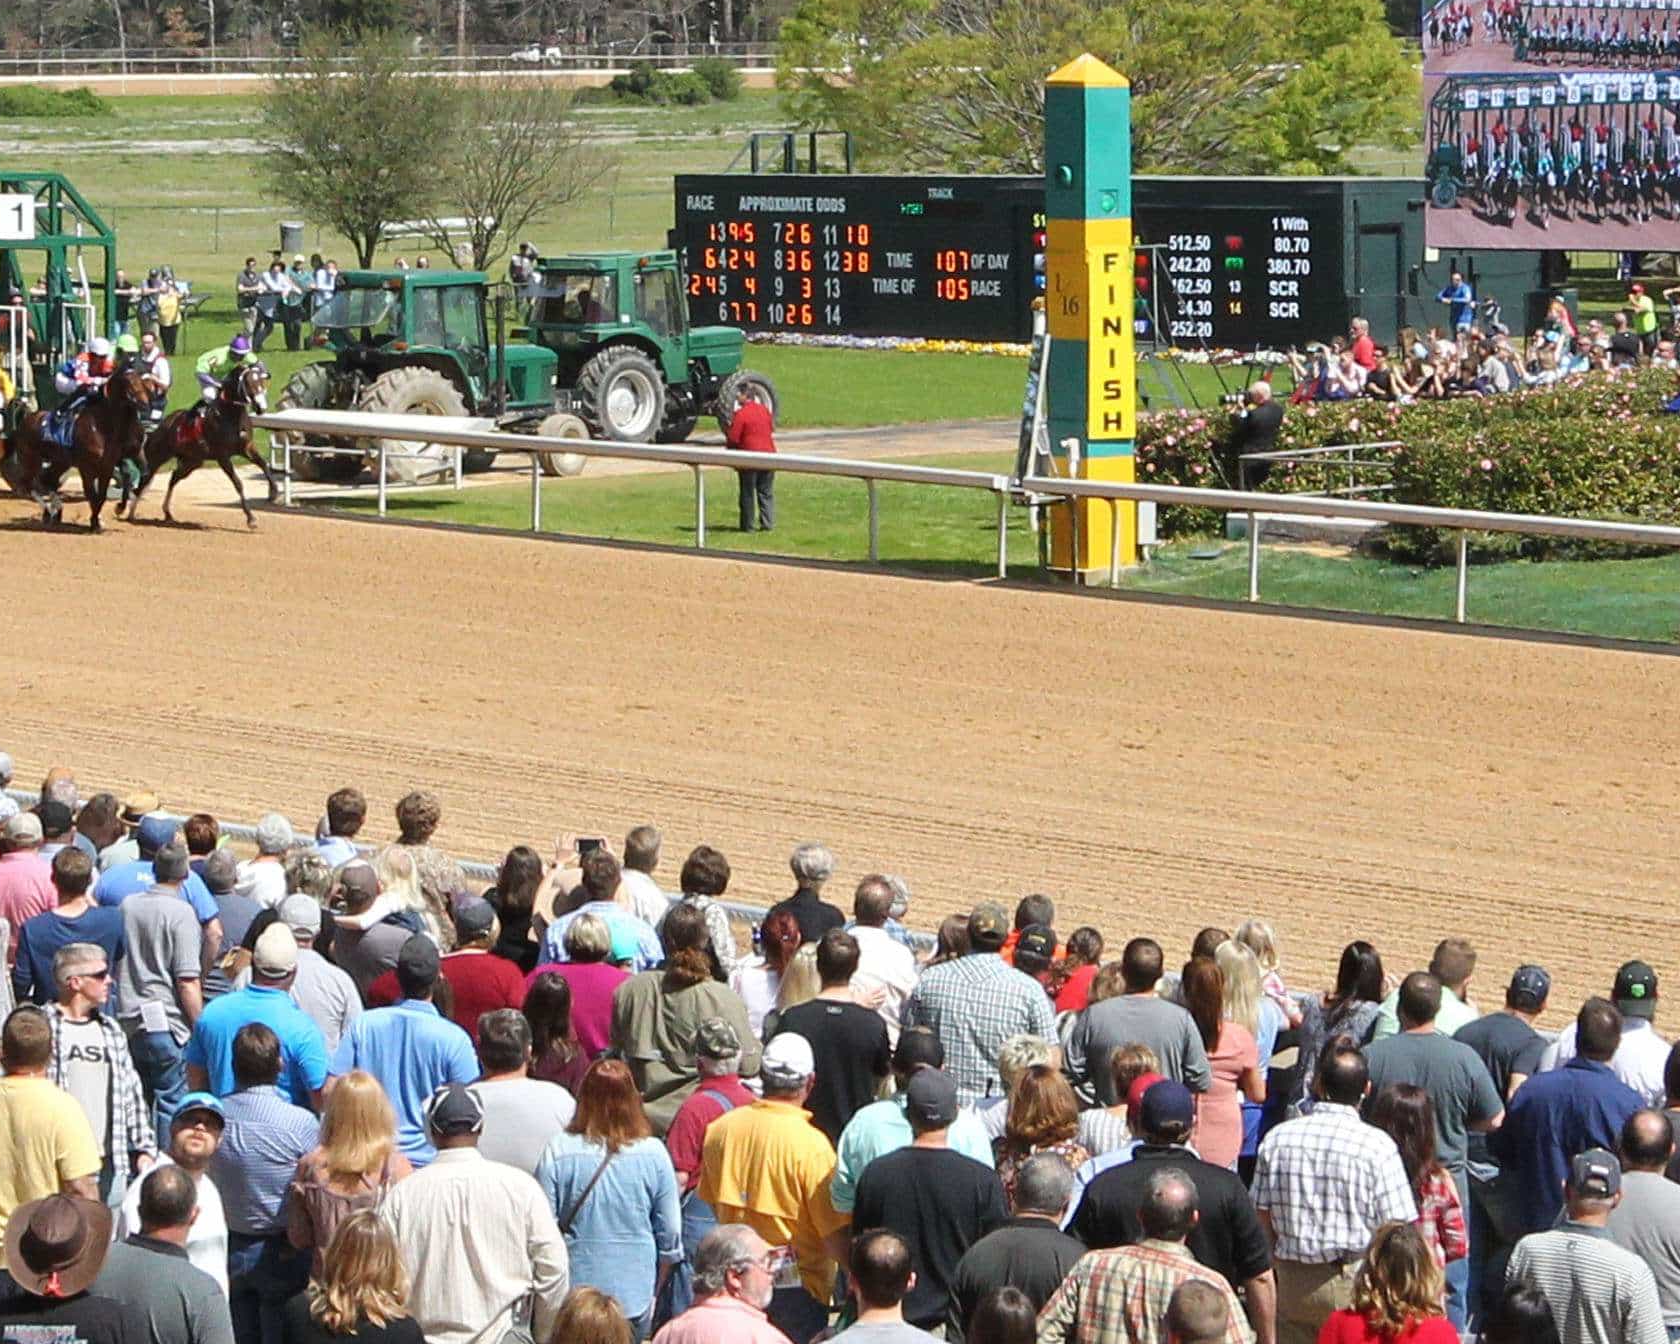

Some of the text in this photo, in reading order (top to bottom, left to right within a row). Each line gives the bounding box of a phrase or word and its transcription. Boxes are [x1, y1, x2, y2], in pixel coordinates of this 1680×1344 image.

[686, 195, 715, 211] RACE
[927, 187, 954, 200] TRACK
[739, 196, 846, 213] APPROXIMATE ODDS
[10, 201, 22, 232] 1
[1272, 217, 1309, 232] 1 With
[709, 223, 716, 241] 1
[717, 221, 727, 242] 3
[773, 222, 811, 244] 7 26
[823, 224, 869, 246] 11 10
[1169, 235, 1211, 251] 512.50
[1274, 237, 1310, 253] 80.70
[705, 248, 716, 269] 6
[718, 248, 755, 270] 4 24
[773, 249, 812, 271] 8 36
[823, 250, 869, 273] 12 38
[886, 252, 913, 269] TIME
[971, 255, 986, 270] OF
[988, 255, 1010, 270] DAY
[1169, 257, 1211, 273] 242.20
[1267, 259, 1310, 274] 380.70
[690, 275, 717, 296] 24
[718, 275, 755, 295] 5 4
[774, 276, 812, 298] 9 3
[824, 277, 840, 298] 13
[872, 278, 899, 294] TIME
[901, 279, 916, 295] OF
[971, 280, 1001, 297] RACE
[1228, 280, 1242, 293] 13
[1269, 280, 1299, 296] SCR
[719, 302, 756, 322] 6 77
[768, 303, 812, 325] 10 26
[825, 304, 841, 326] 14
[1229, 302, 1242, 315] 14
[1269, 302, 1300, 318] SCR
[1171, 321, 1212, 338] 252.20
[1102, 253, 1122, 433] FINISH
